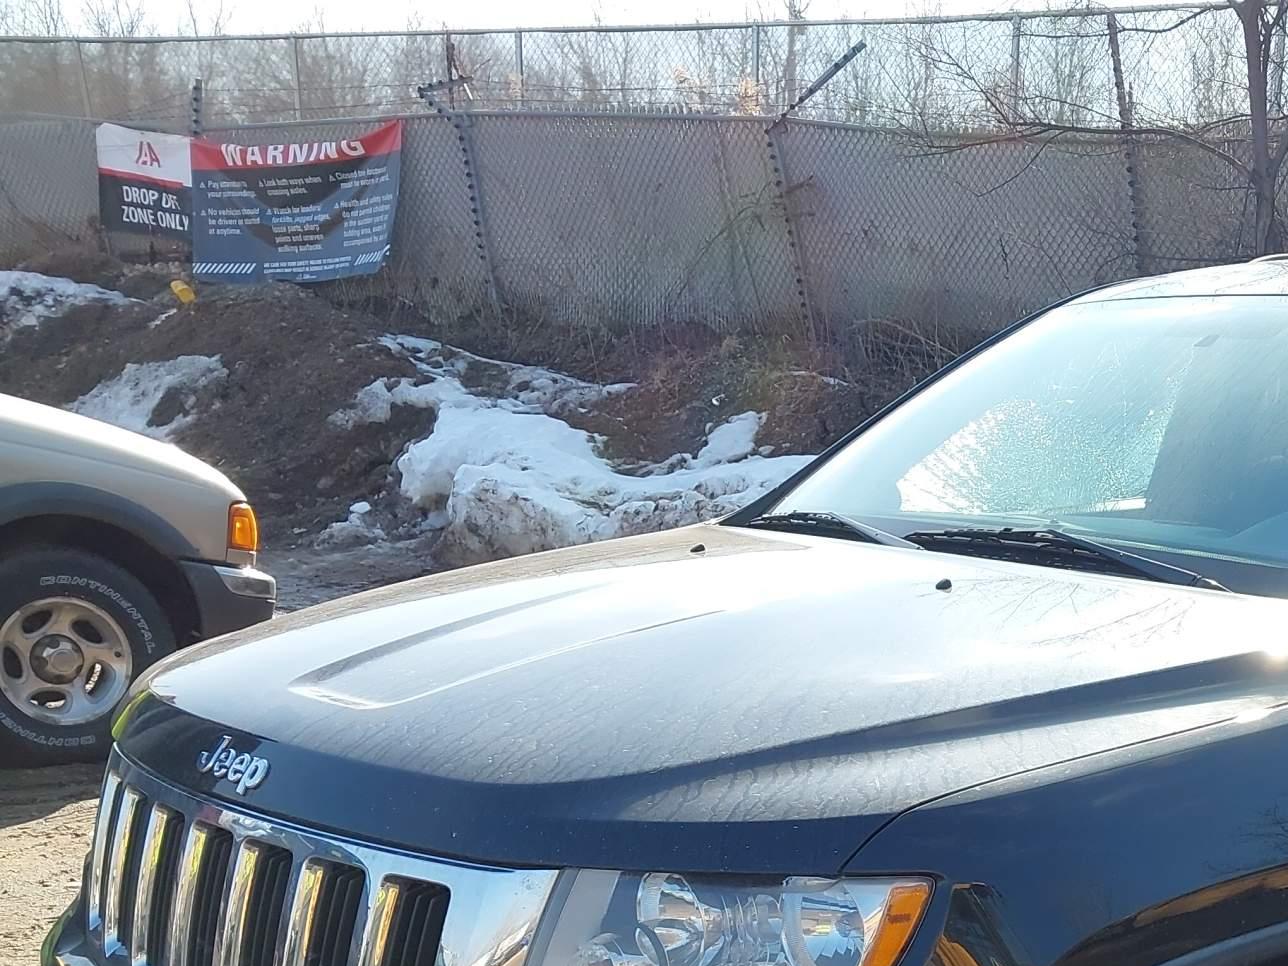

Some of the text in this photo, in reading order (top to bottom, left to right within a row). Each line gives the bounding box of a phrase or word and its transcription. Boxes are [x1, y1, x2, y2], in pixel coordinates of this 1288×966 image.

[221, 140, 365, 166] WARNING
[122, 186, 159, 206] DROP
[121, 205, 189, 231] ZONE ONLY
[40, 575, 156, 654] CONTINENTAL
[199, 734, 269, 795] Jeep
